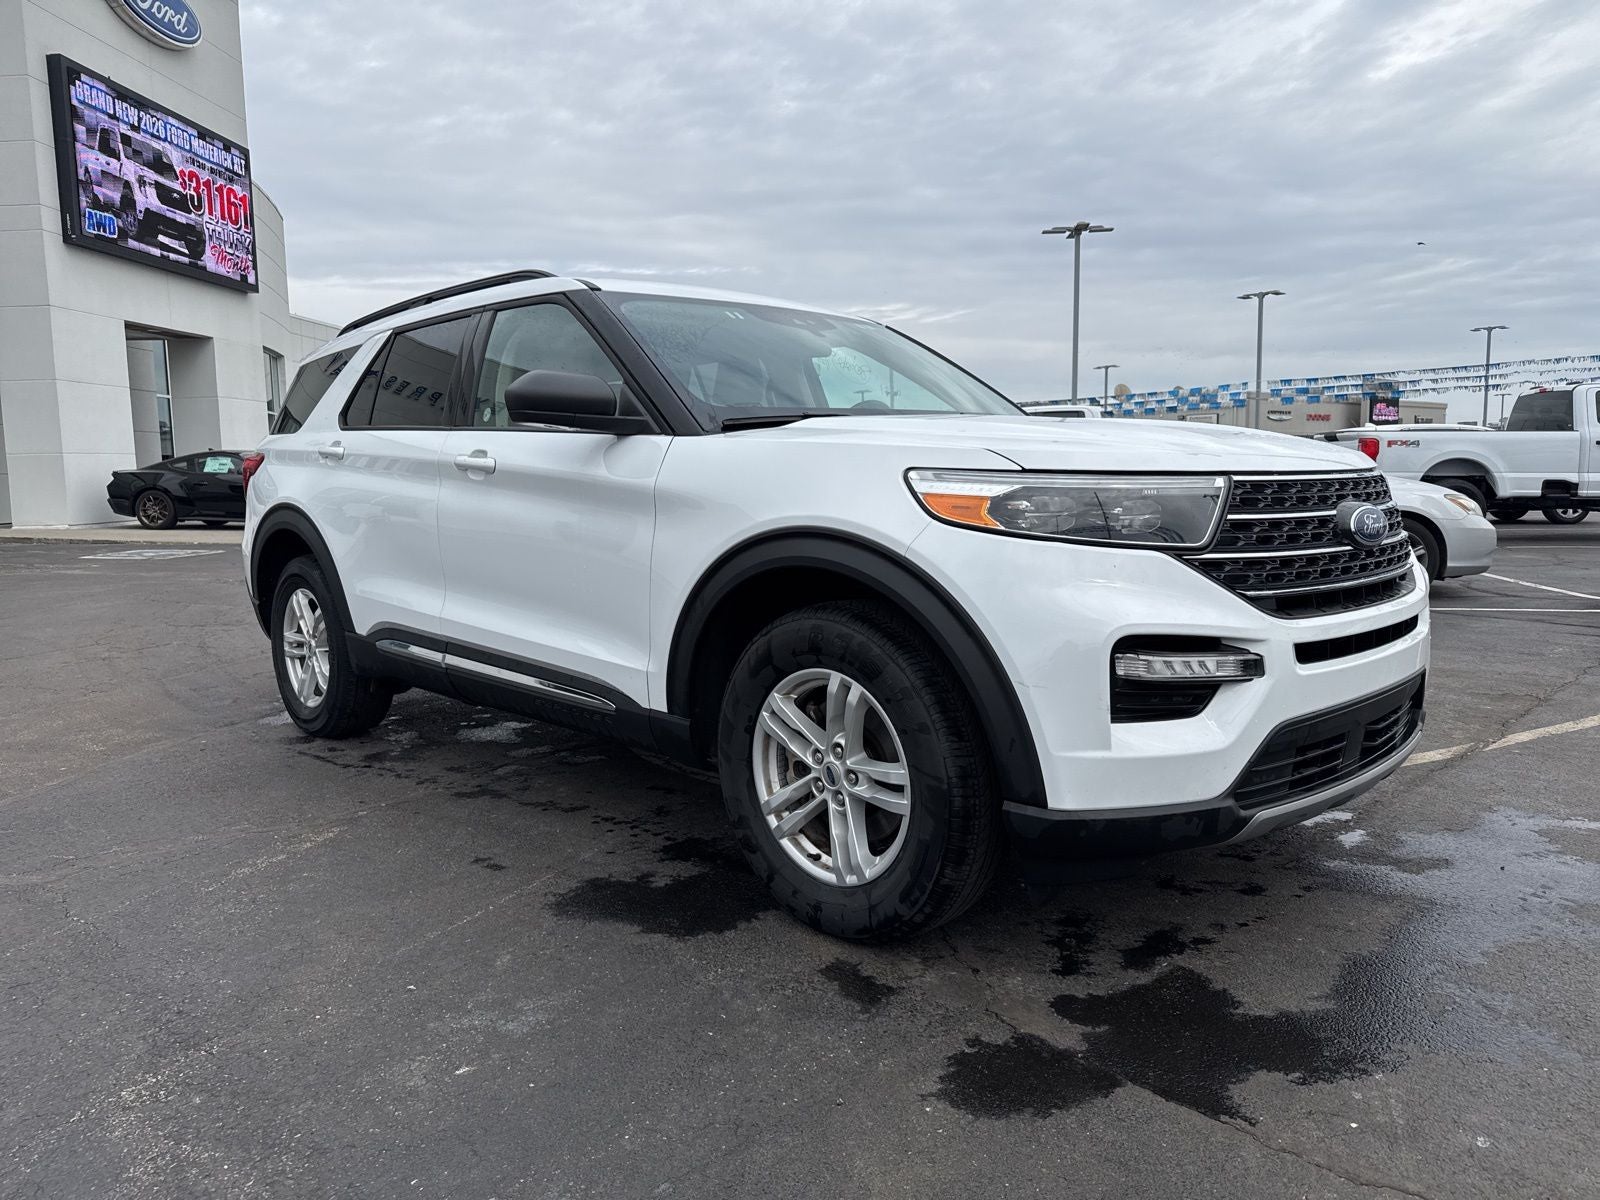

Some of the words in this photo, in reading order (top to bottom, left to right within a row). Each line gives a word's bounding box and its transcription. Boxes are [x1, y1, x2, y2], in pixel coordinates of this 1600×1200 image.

[138, 0, 188, 33] ord
[75, 80, 114, 115] BRAND
[114, 98, 139, 127] NEW
[140, 111, 166, 139] 2026
[166, 123, 190, 150] FORD
[190, 134, 233, 170] MAVERICK
[232, 154, 246, 176] XLT
[86, 208, 118, 238] AWD
[205, 221, 254, 262] TRUCK
[1363, 513, 1386, 535] Ford
